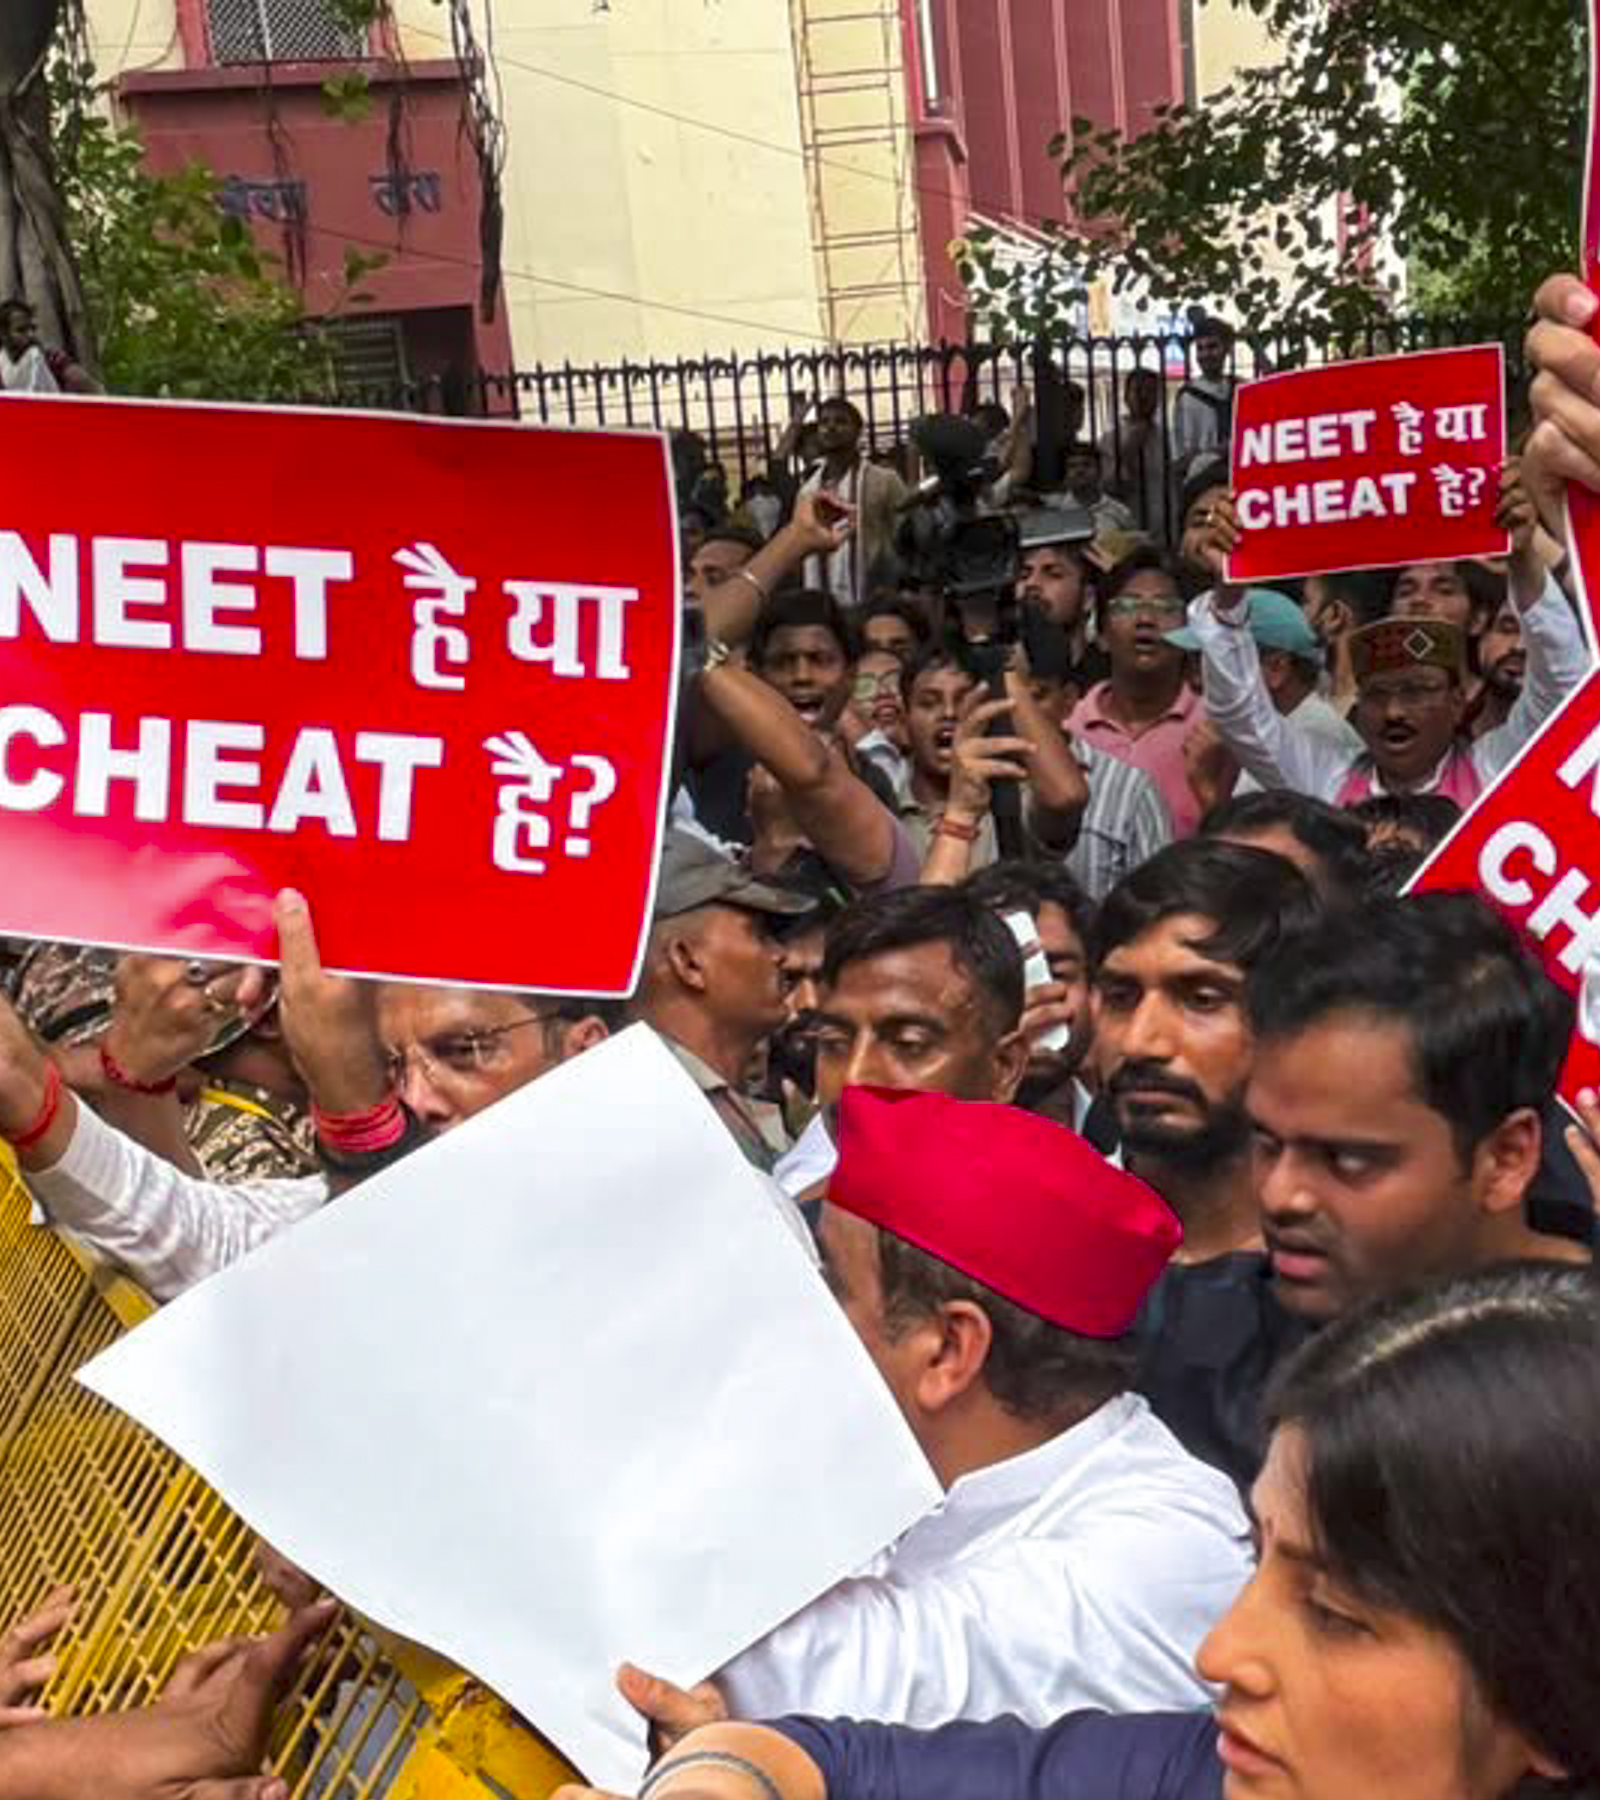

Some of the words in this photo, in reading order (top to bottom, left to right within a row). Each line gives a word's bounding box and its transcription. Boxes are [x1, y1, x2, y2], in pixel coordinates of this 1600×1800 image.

[1240, 409, 1377, 467] NEET
[1391, 401, 1424, 456] है
[1434, 403, 1488, 442] या
[1235, 472, 1417, 530] CHEAT
[1431, 463, 1487, 517] है?
[392, 541, 478, 691] है
[501, 579, 640, 680] या
[481, 730, 617, 874] है?
